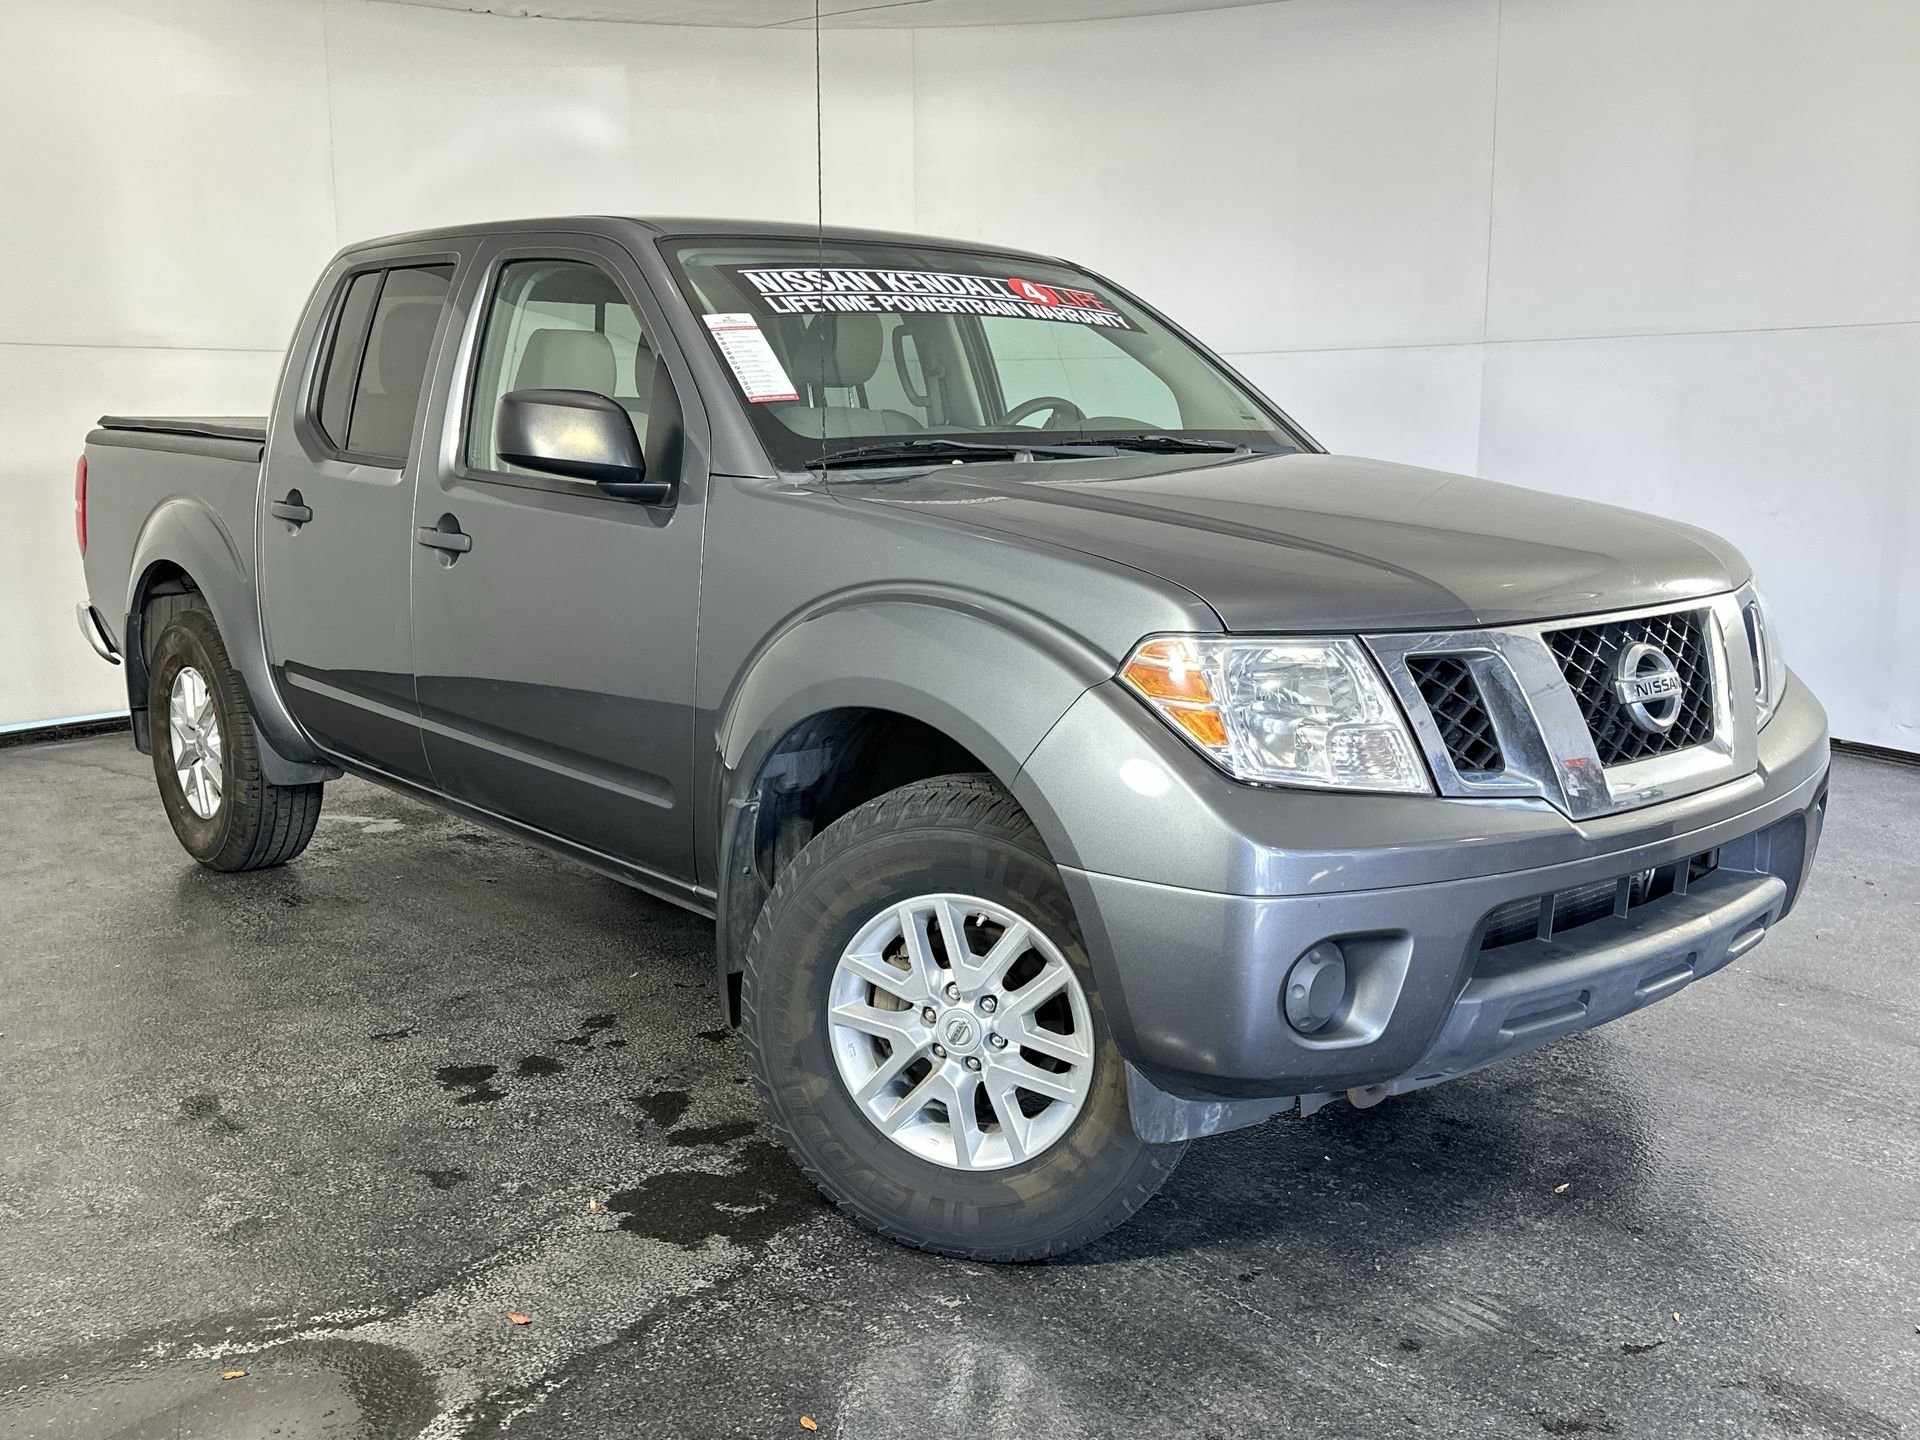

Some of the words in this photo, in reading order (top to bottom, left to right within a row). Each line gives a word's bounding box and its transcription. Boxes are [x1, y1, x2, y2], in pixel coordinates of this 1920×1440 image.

[744, 271, 882, 293] NISSAN
[876, 272, 1022, 300] KENDALL
[1021, 281, 1049, 303] 4
[1051, 287, 1113, 312] LIFE
[764, 295, 883, 314] LIFETIME
[874, 295, 1026, 317] POWERTRAIN
[1020, 302, 1132, 330] WARRANTY
[1635, 676, 1681, 697] NISSAN
